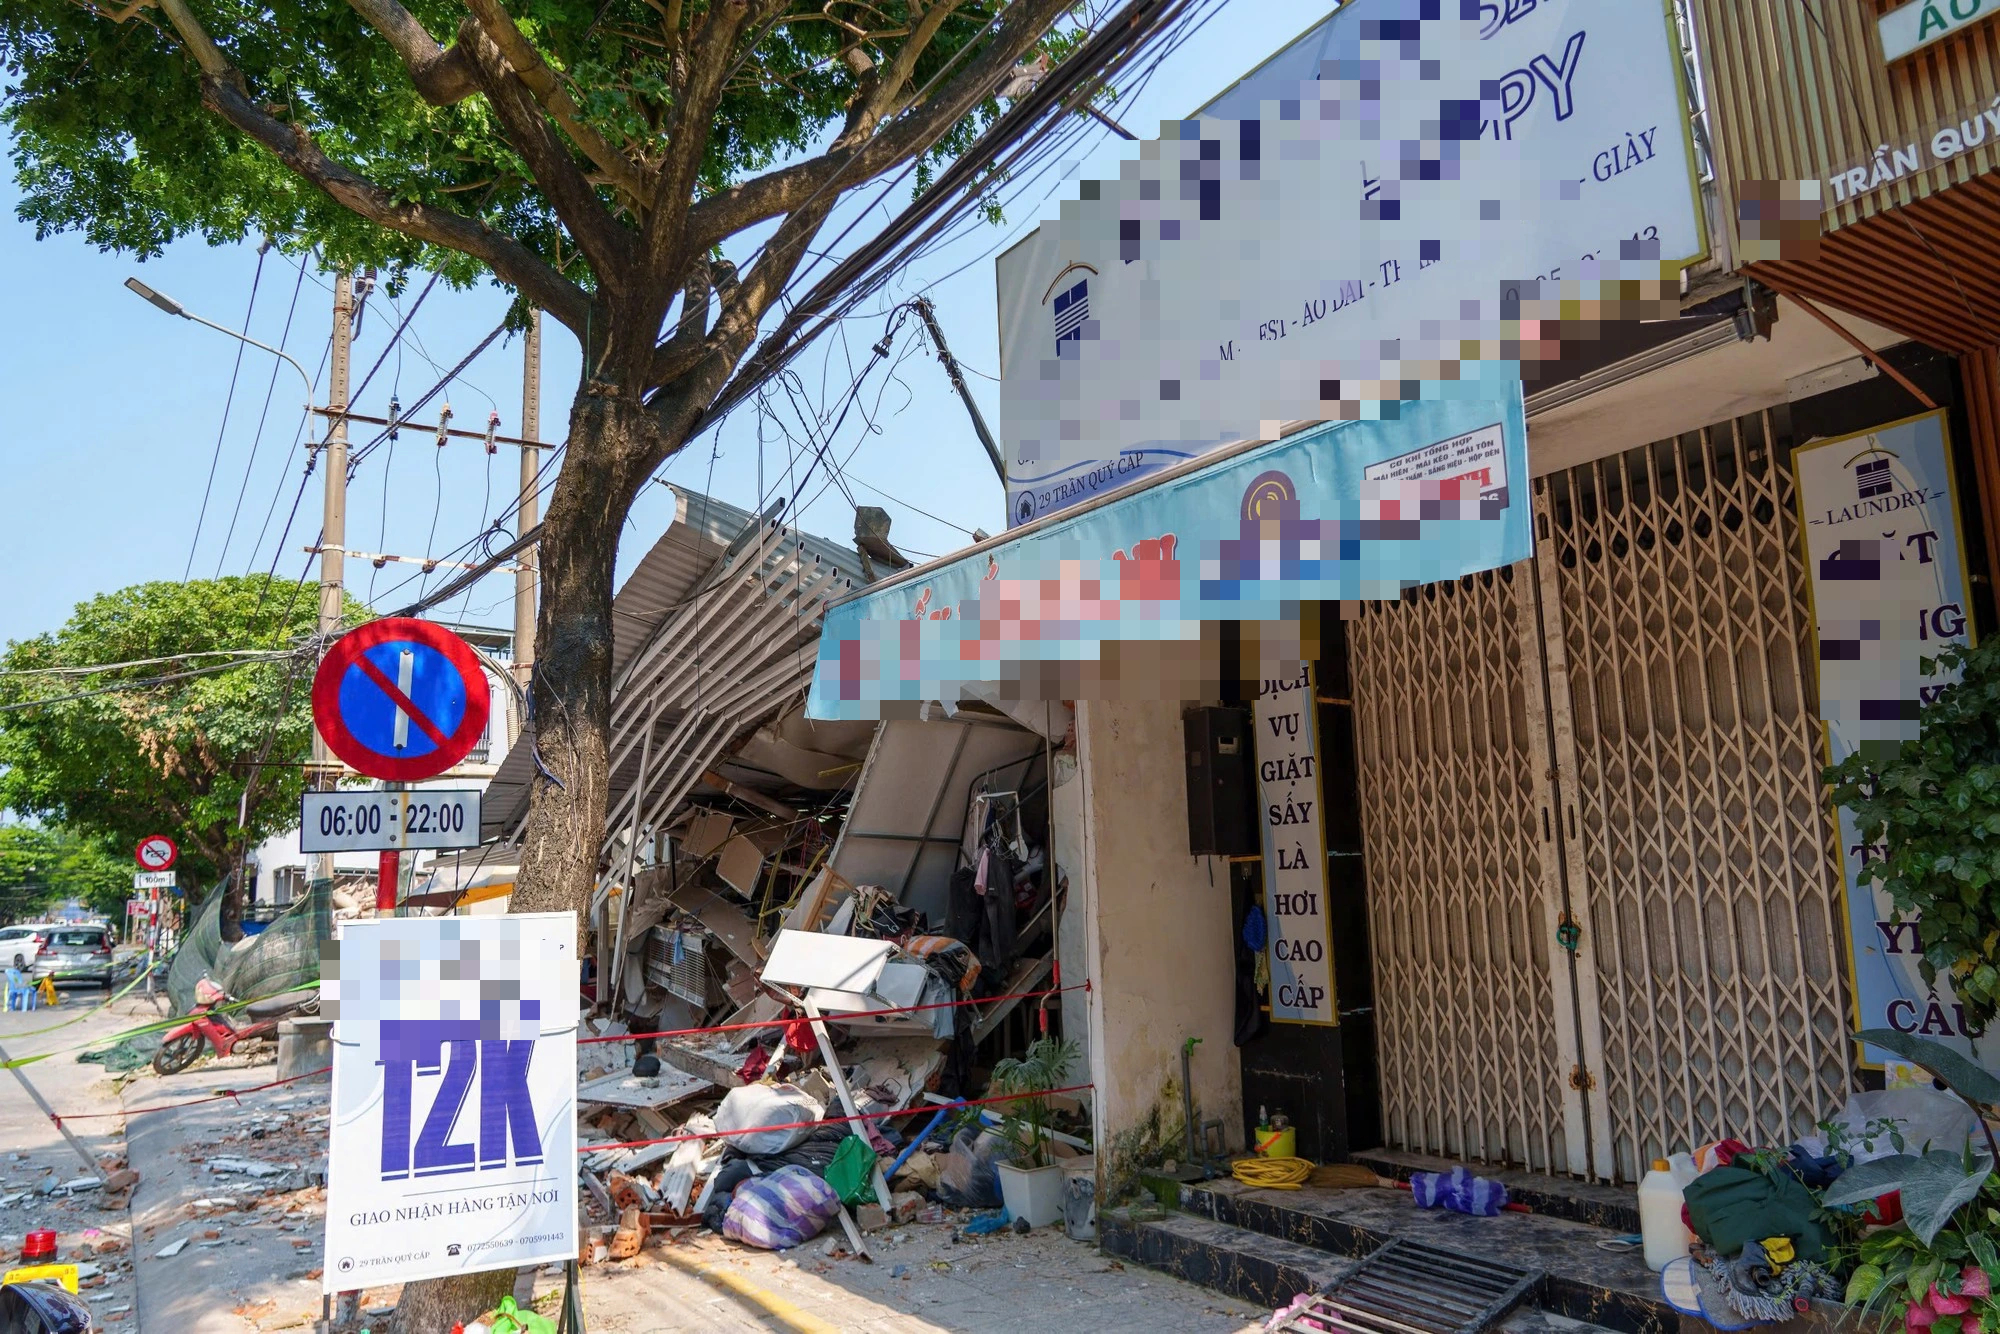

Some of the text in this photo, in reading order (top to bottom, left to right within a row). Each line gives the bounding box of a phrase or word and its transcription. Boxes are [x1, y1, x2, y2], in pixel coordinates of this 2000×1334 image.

[1593, 126, 1657, 182] GIÀY
[1390, 459, 1403, 469] CƠ
[1405, 453, 1421, 464] KHÍ
[1038, 491, 1051, 509] 29
[1088, 460, 1115, 491] QUÝ
[1117, 451, 1144, 474] CÁP
[1827, 487, 1930, 525] LAUNDRY
[1268, 712, 1300, 742] VỤ
[1261, 752, 1316, 787] GIẶT
[320, 804, 381, 837] 06:00
[405, 803, 464, 834] 22:00
[1269, 791, 1313, 826] SẤY
[1278, 841, 1309, 871] LÀ
[1274, 891, 1318, 917] HƠI
[1275, 939, 1323, 963] CAO
[1278, 975, 1325, 1009] CẤP
[350, 1188, 559, 1227] GIAO NHẬN HÀNG TẬN NƠI
[359, 1259, 369, 1268] 29
